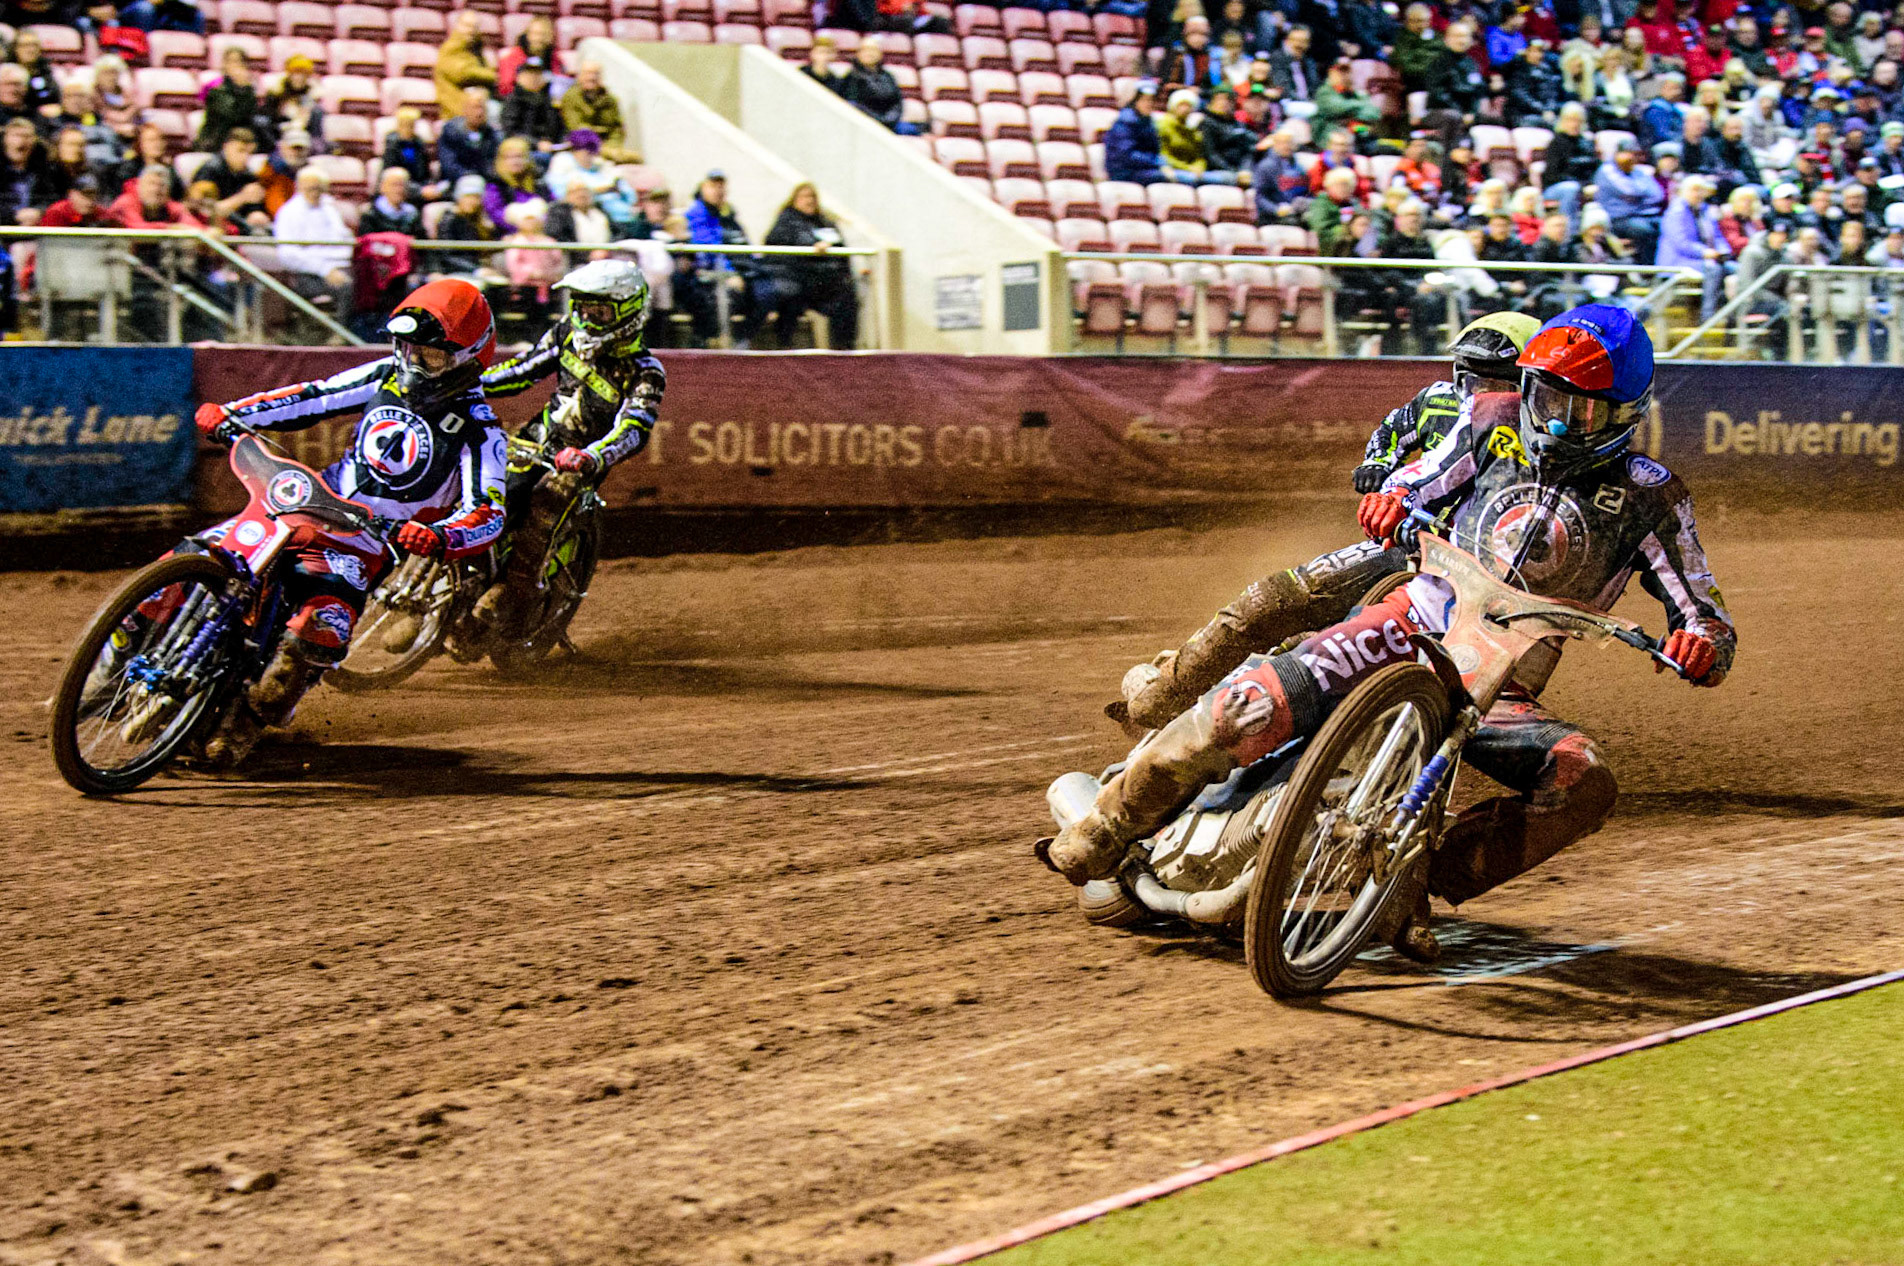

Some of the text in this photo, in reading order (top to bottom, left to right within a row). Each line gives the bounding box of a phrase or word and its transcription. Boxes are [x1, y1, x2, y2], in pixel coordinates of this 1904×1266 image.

[77, 404, 180, 445] Lane
[369, 410, 402, 424] BELLE
[418, 433, 429, 460] ACES
[688, 420, 924, 467] SOLICITORS
[1704, 409, 1900, 467] Delivering
[1635, 460, 1663, 478] ATPI
[1494, 490, 1537, 514] BELLE
[1564, 510, 1584, 553] ACES
[1299, 618, 1413, 692] Nice
